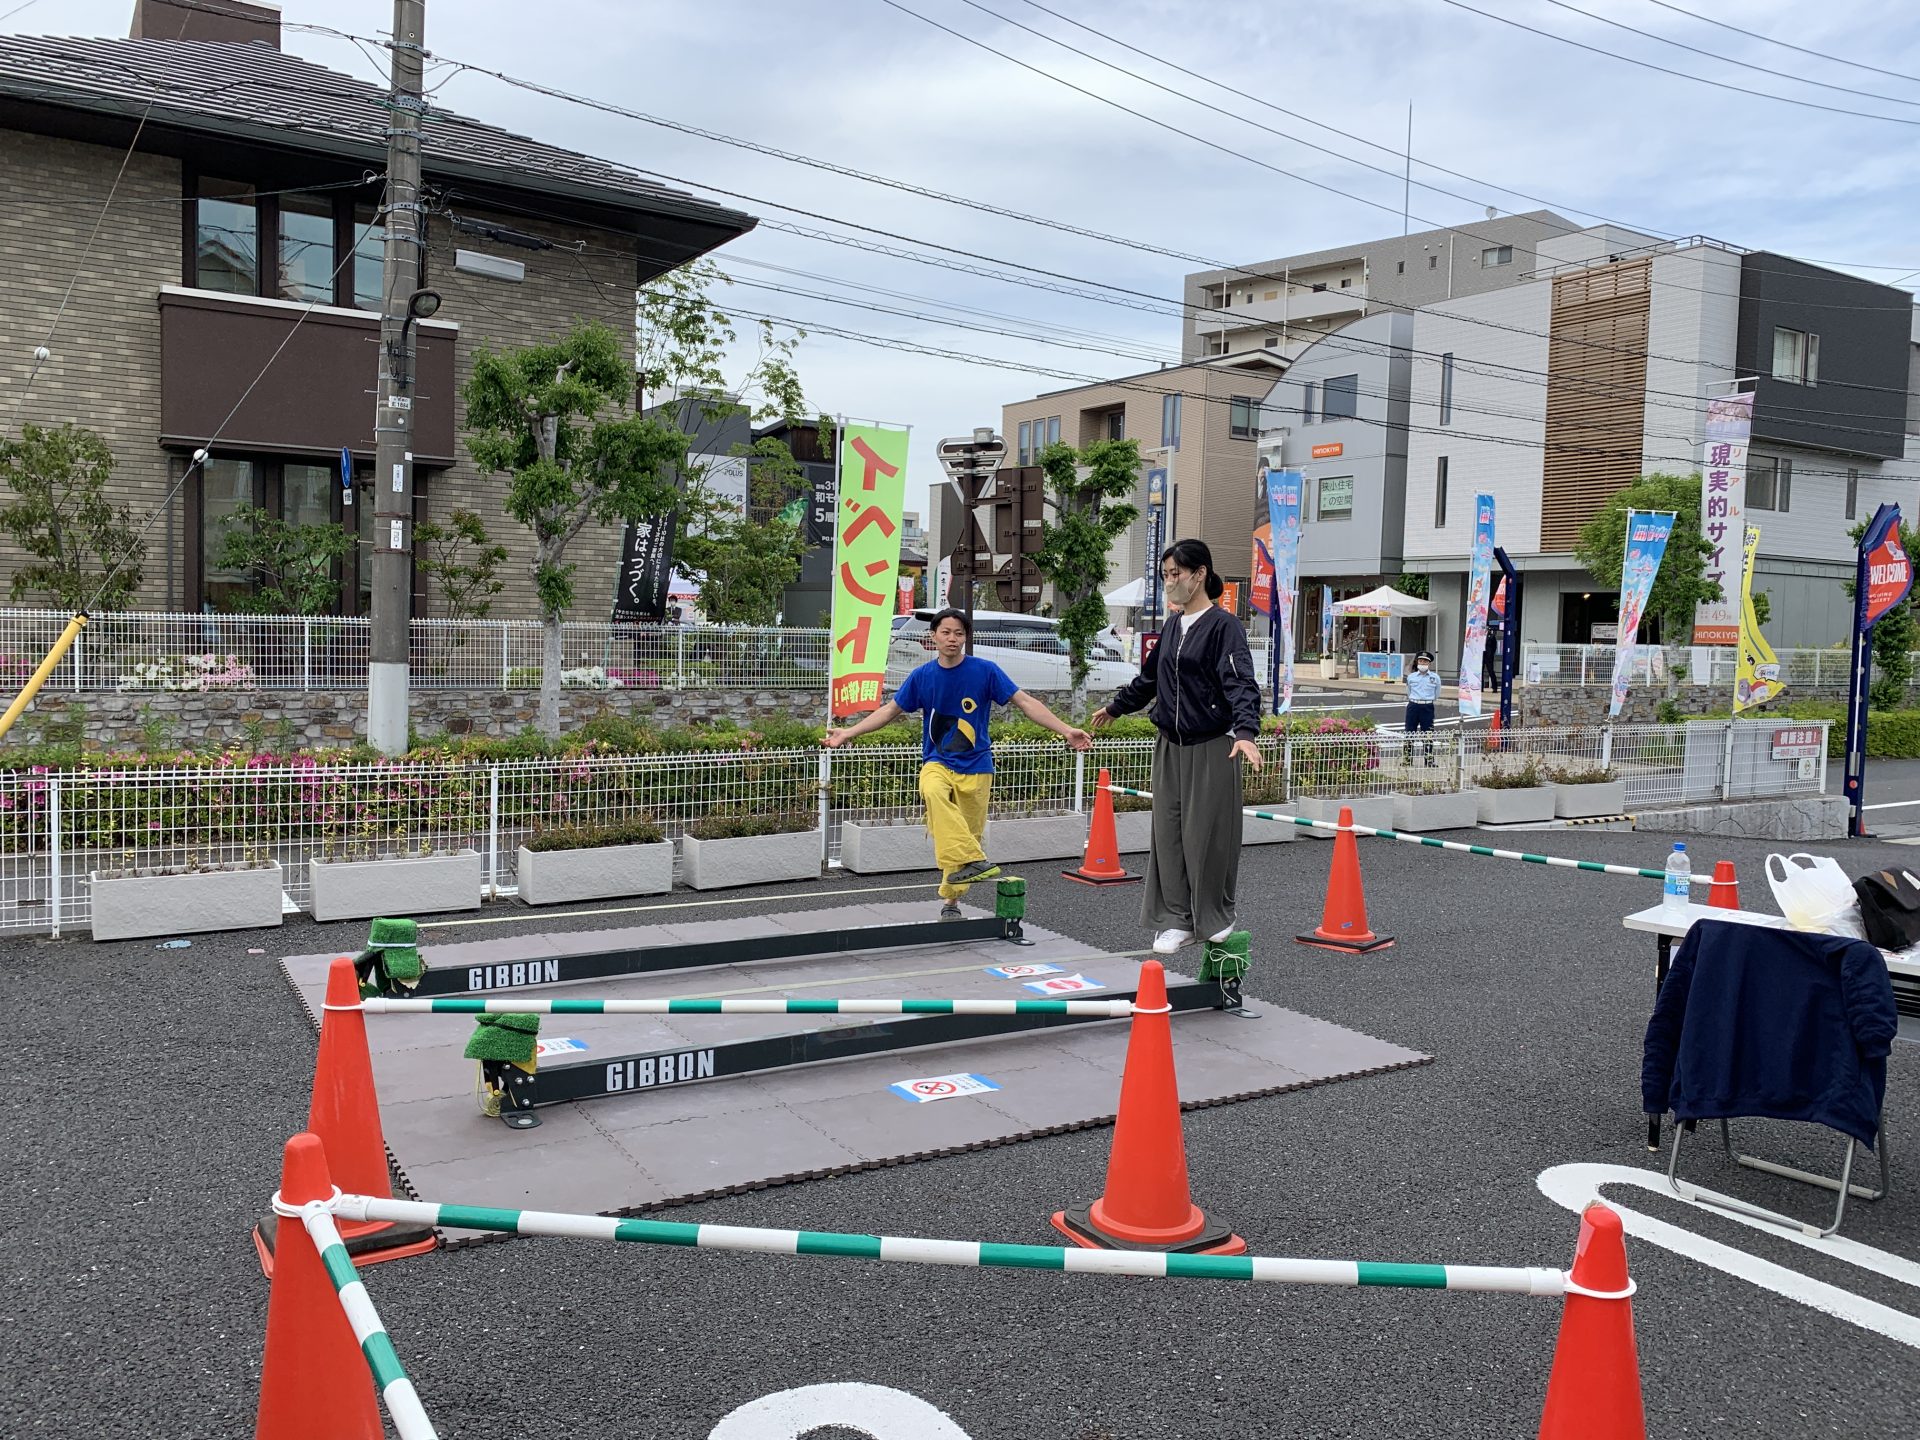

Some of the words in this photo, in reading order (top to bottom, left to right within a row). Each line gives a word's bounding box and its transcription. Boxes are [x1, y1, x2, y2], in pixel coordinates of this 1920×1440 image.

[1729, 448, 1742, 516] リアル
[1870, 562, 1908, 585] WELCOME
[1695, 631, 1738, 640] HINOKIYA
[468, 959, 559, 991] GIBBON
[606, 1049, 715, 1092] GIBBON
